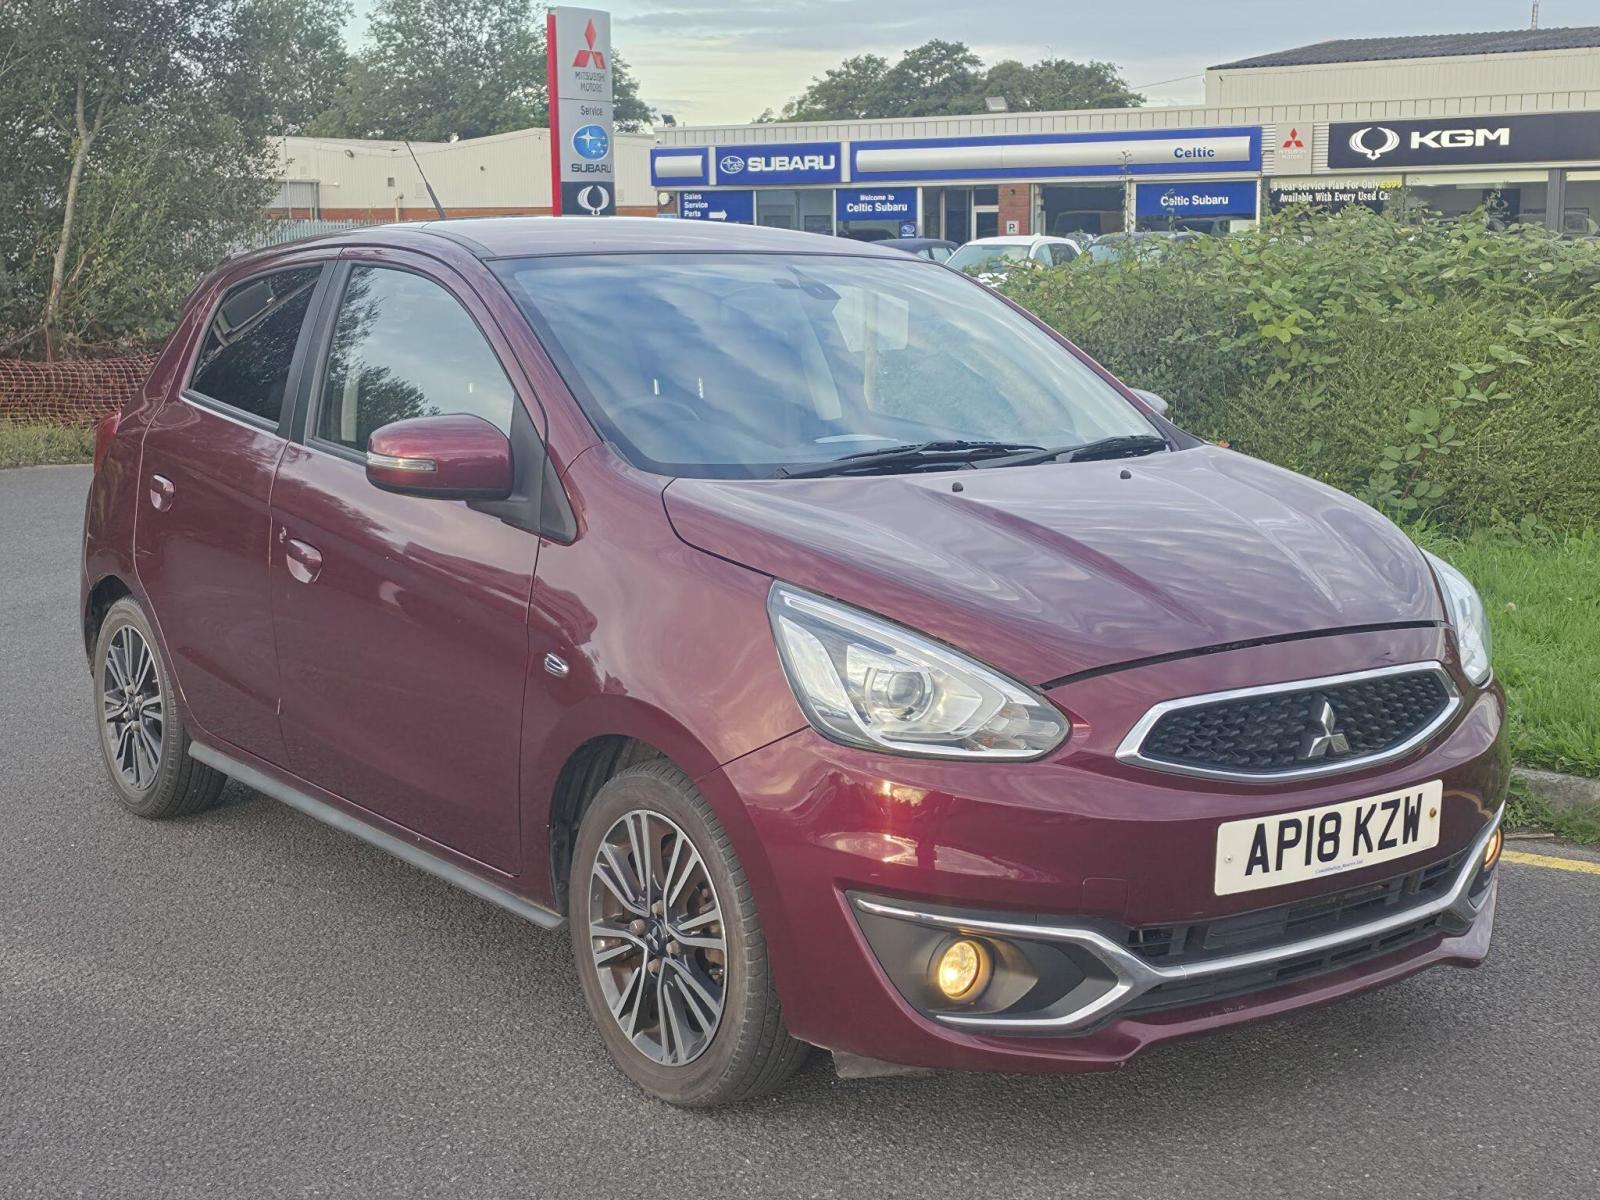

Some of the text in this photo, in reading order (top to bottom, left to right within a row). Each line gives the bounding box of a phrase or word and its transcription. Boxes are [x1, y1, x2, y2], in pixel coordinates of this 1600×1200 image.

[580, 105, 603, 116] Service
[1410, 127, 1510, 149] KGM
[1174, 146, 1215, 159] Celtic
[571, 163, 611, 174] SUBARU
[747, 154, 836, 172] SUBARU
[1361, 179, 1379, 191] Only
[1160, 194, 1230, 207] Celtic Subaru
[1279, 192, 1313, 202] Available
[1315, 191, 1333, 202] With
[1334, 191, 1356, 203] Every
[1358, 190, 1377, 201] Used
[684, 210, 702, 218] Parts
[847, 202, 908, 213] Celtic Subaru
[1244, 792, 1423, 876] AP18 KZW
